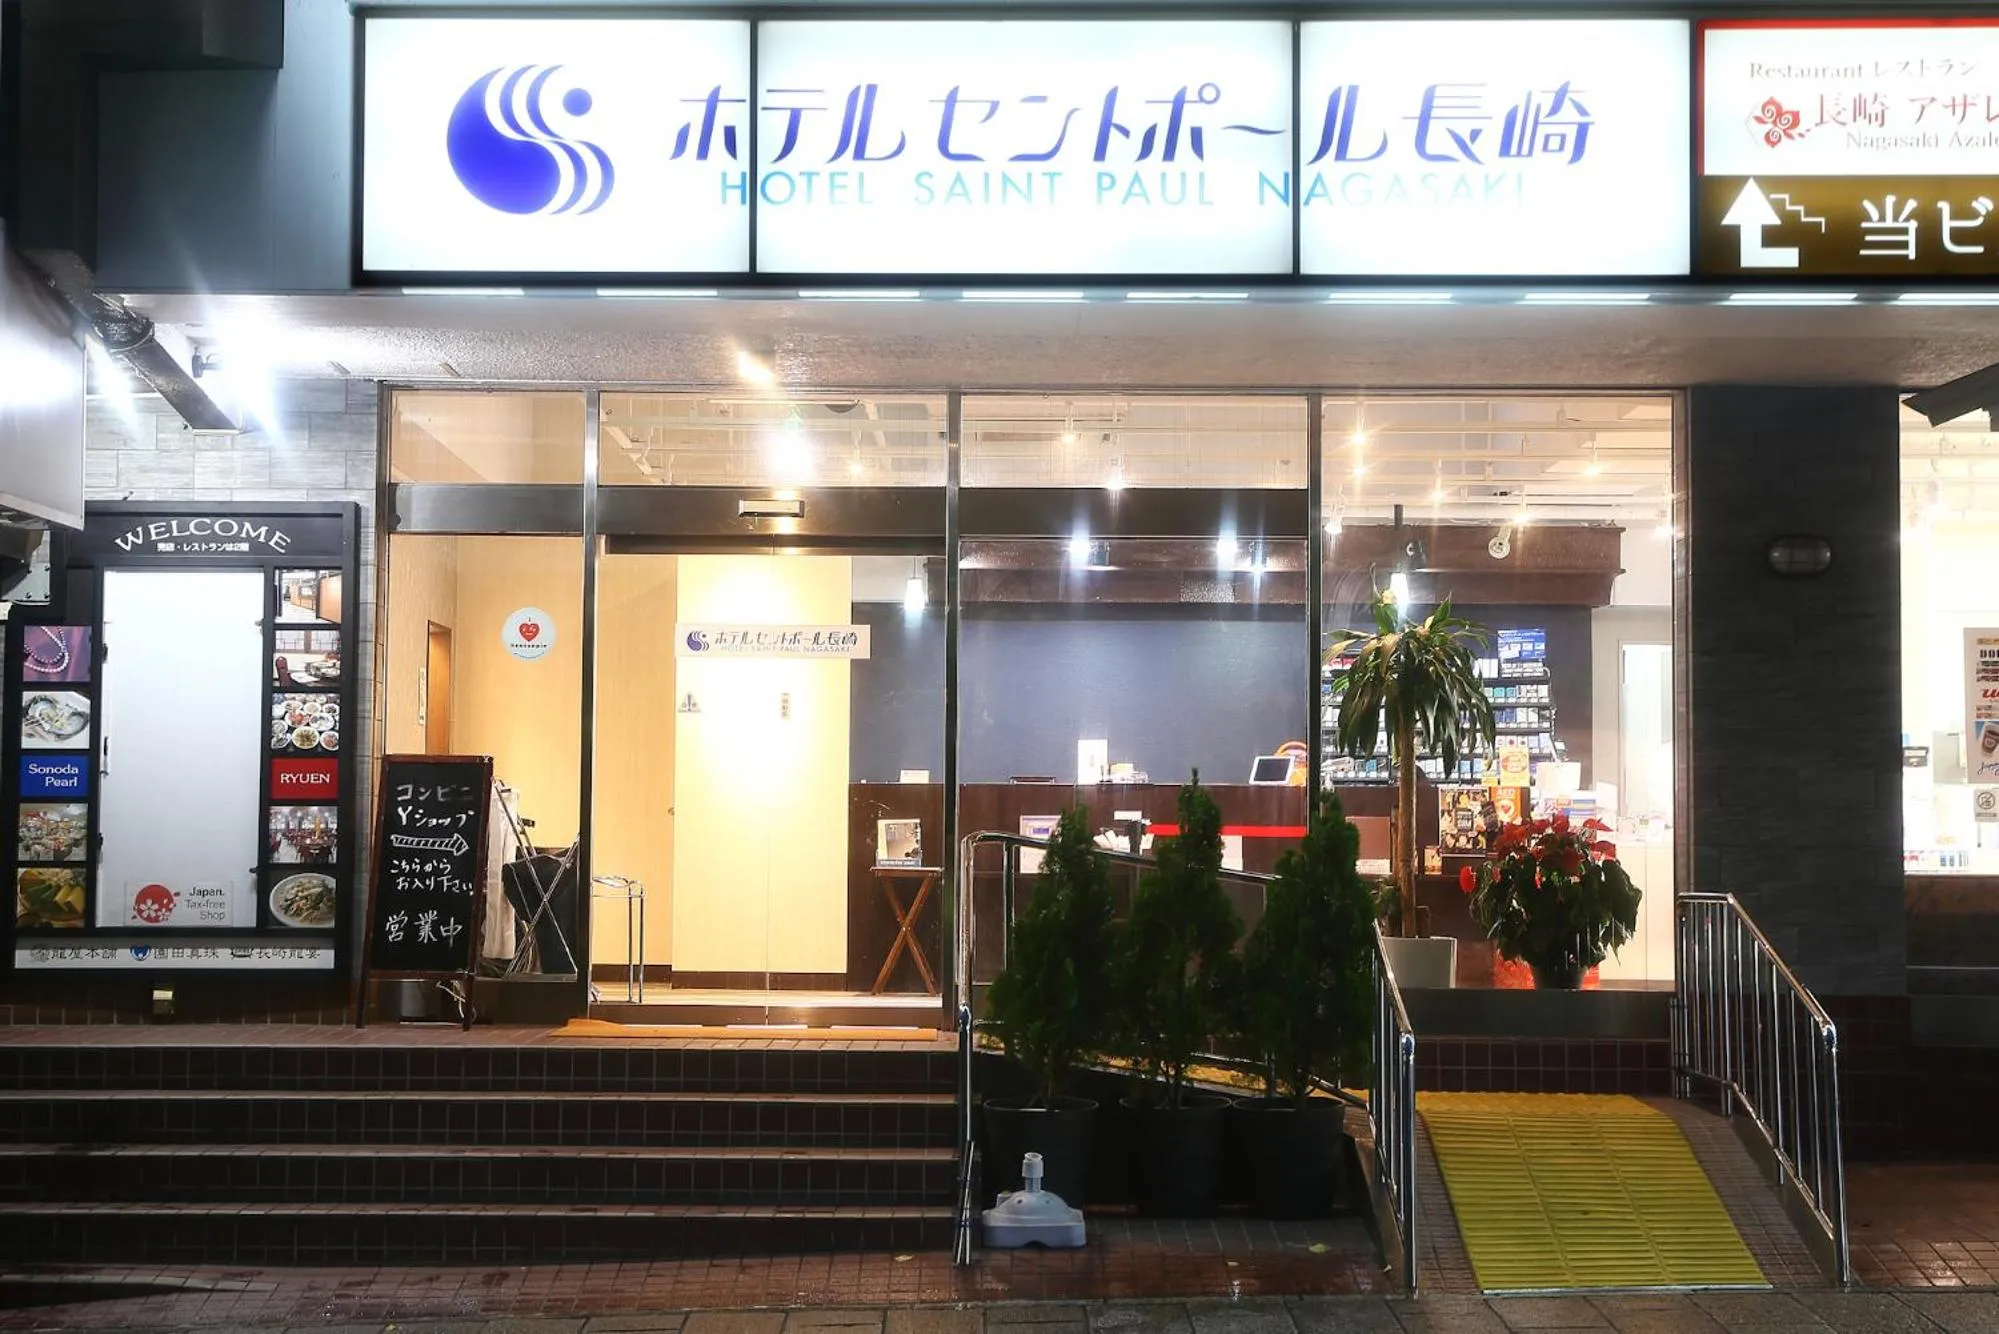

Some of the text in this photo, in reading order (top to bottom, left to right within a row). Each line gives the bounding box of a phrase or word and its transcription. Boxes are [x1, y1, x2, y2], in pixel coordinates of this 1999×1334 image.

[1749, 57, 1977, 80] Restaurant レストラン
[1815, 92, 1890, 128] 長崎
[669, 80, 1596, 166] ホテルセントポール長崎
[1847, 131, 1939, 151] Nagasaki
[720, 171, 1524, 208] HOTEL SAINT PAUL NAGASAKI
[115, 518, 291, 553] WELCOME
[804, 645, 850, 653] NAGASAKI
[28, 763, 79, 775] Sonoda
[45, 776, 78, 788] Pearl
[280, 773, 331, 784] RYUEN
[396, 784, 474, 801] コンビニ
[397, 805, 475, 828] Yショップ
[390, 858, 452, 875] こちらから
[188, 887, 226, 899] Japan.
[184, 899, 226, 909] Tax-free
[200, 911, 226, 922] Shop
[384, 909, 463, 947] 営業中
